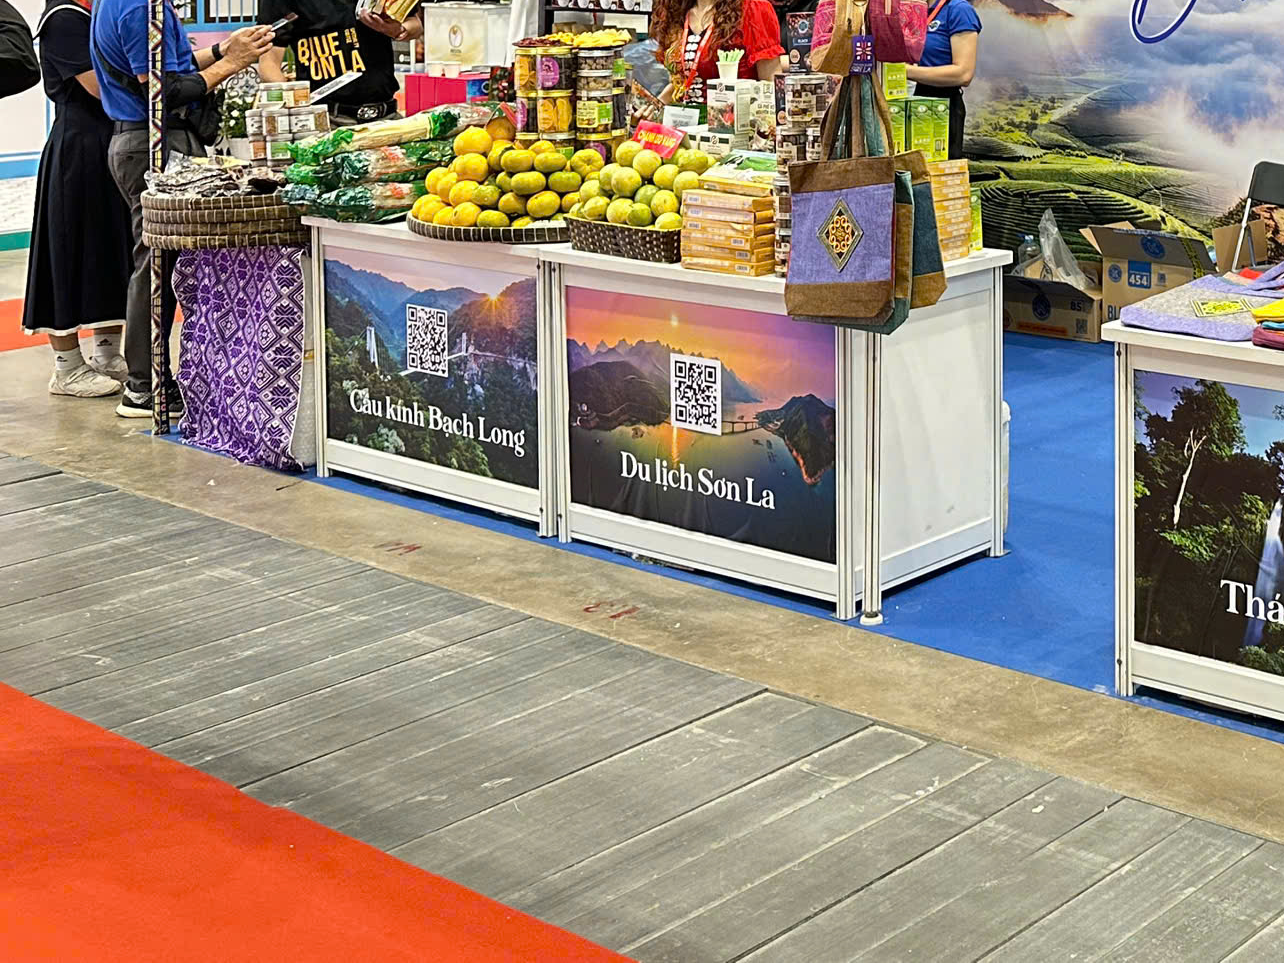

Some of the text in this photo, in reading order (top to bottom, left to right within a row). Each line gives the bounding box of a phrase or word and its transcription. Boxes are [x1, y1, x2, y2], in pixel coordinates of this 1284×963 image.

[1129, 274, 1148, 285] 454
[386, 396, 425, 428] kính
[427, 405, 475, 438] Bạch
[478, 416, 526, 458] Long
[620, 450, 776, 510] Du lịch Sơn La
